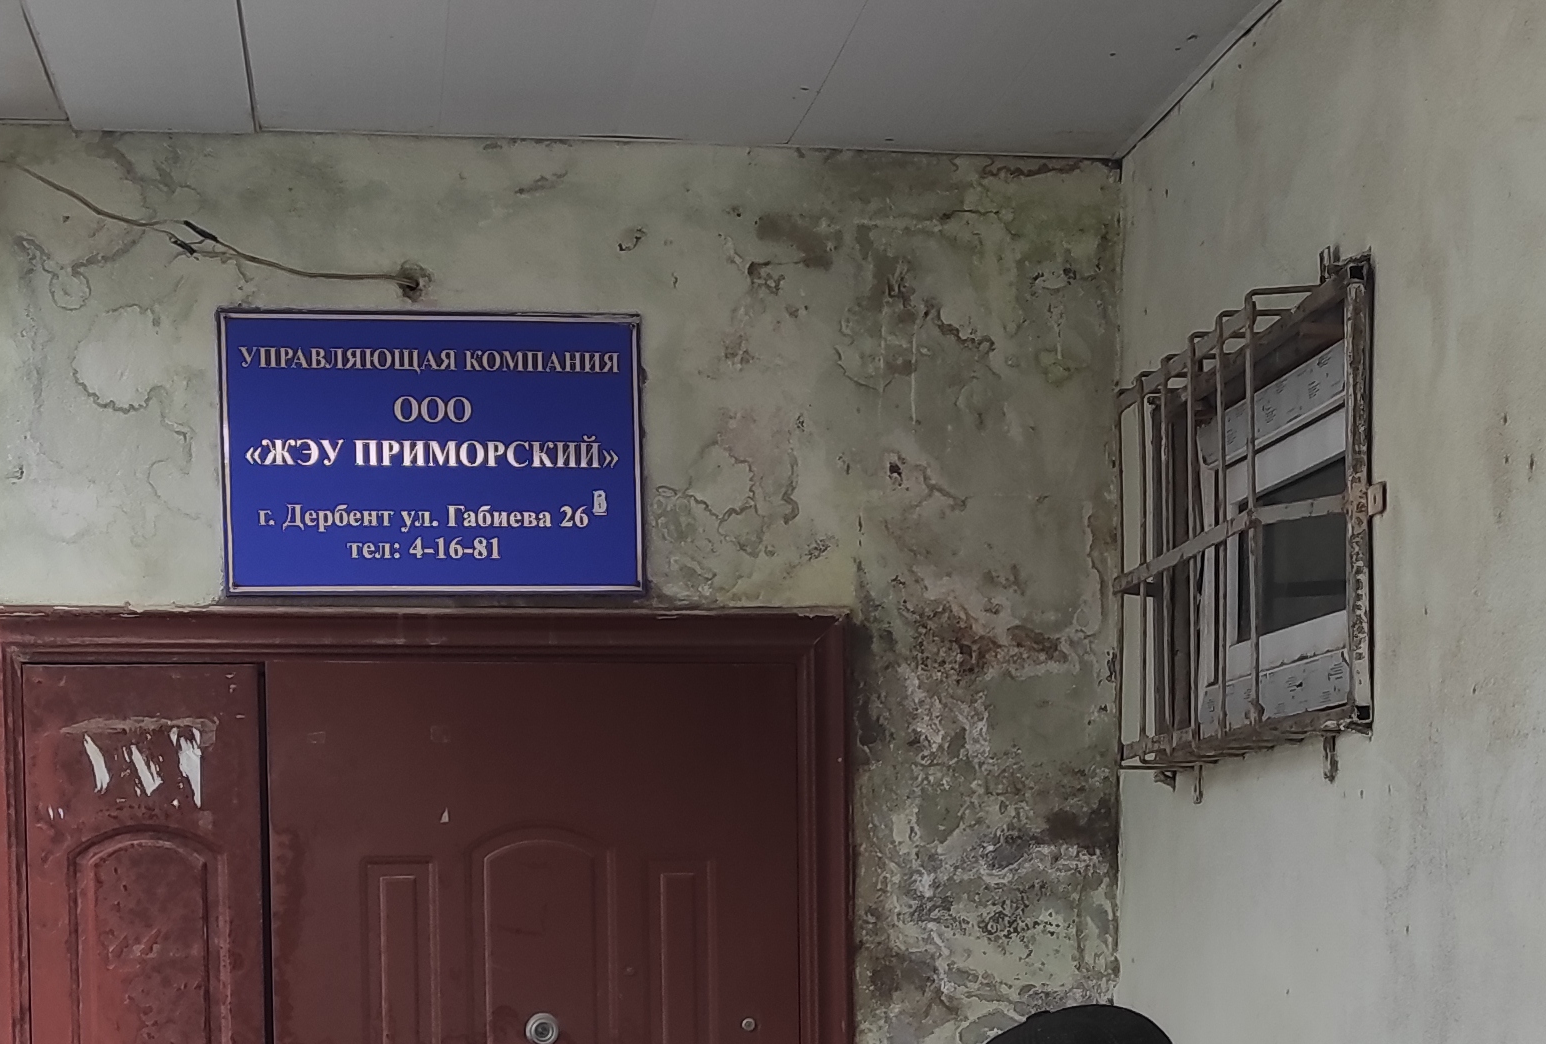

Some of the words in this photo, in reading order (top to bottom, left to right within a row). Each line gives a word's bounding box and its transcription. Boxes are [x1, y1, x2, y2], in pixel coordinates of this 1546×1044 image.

[238, 346, 457, 374] УПРАВЛЯЮЩАЯ
[464, 350, 620, 373] КОМПАНИЯ
[393, 396, 472, 423] ООО
[244, 438, 344, 466] «ЖЭУ
[354, 436, 620, 469] ПРИМОРСКИЙ»
[258, 509, 276, 527] г.
[282, 504, 395, 531] Дербент
[401, 509, 438, 531] ул.
[447, 504, 552, 527] Габиева
[347, 539, 401, 560] тел:
[409, 537, 501, 559] 4-16-81
